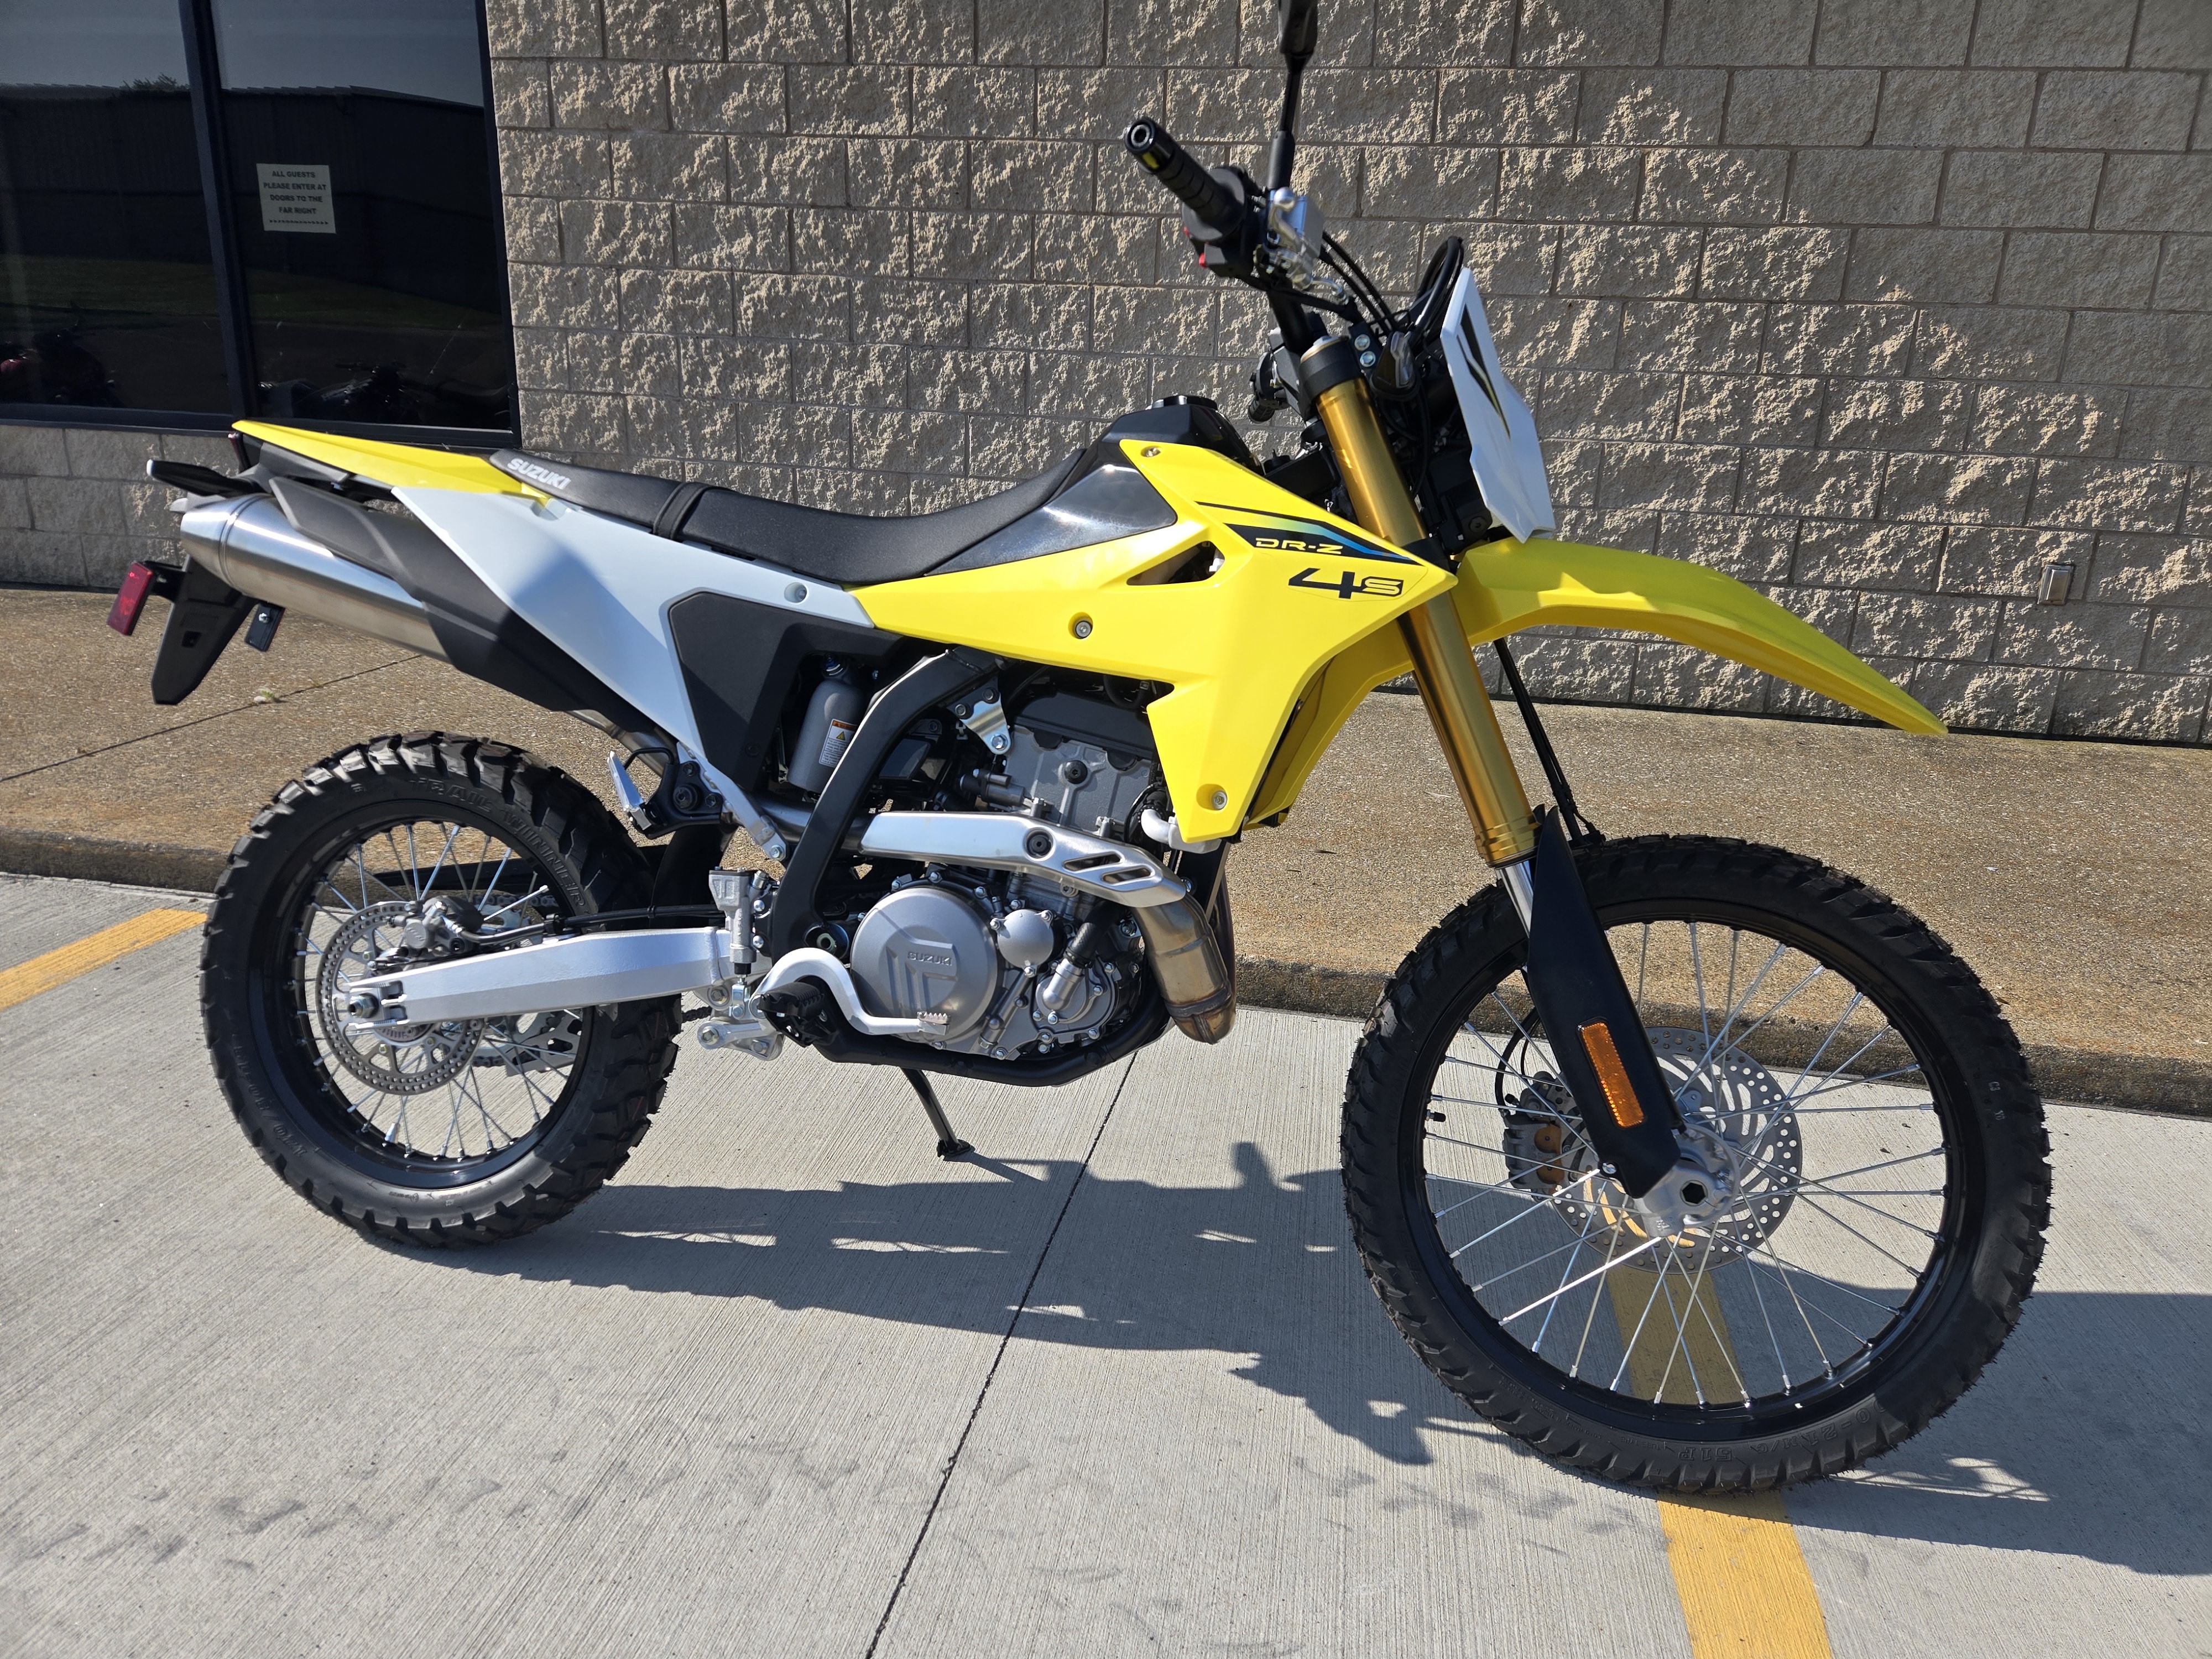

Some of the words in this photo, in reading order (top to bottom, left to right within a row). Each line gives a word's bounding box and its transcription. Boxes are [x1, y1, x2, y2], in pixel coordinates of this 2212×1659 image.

[507, 458, 571, 490] SUZUKI
[1255, 537, 1343, 555] DR-Z
[407, 777, 493, 812] TRAIL
[500, 810, 585, 906] WINNER
[907, 952, 952, 966] SUZUKI
[1677, 1447, 1733, 1462] 51P
